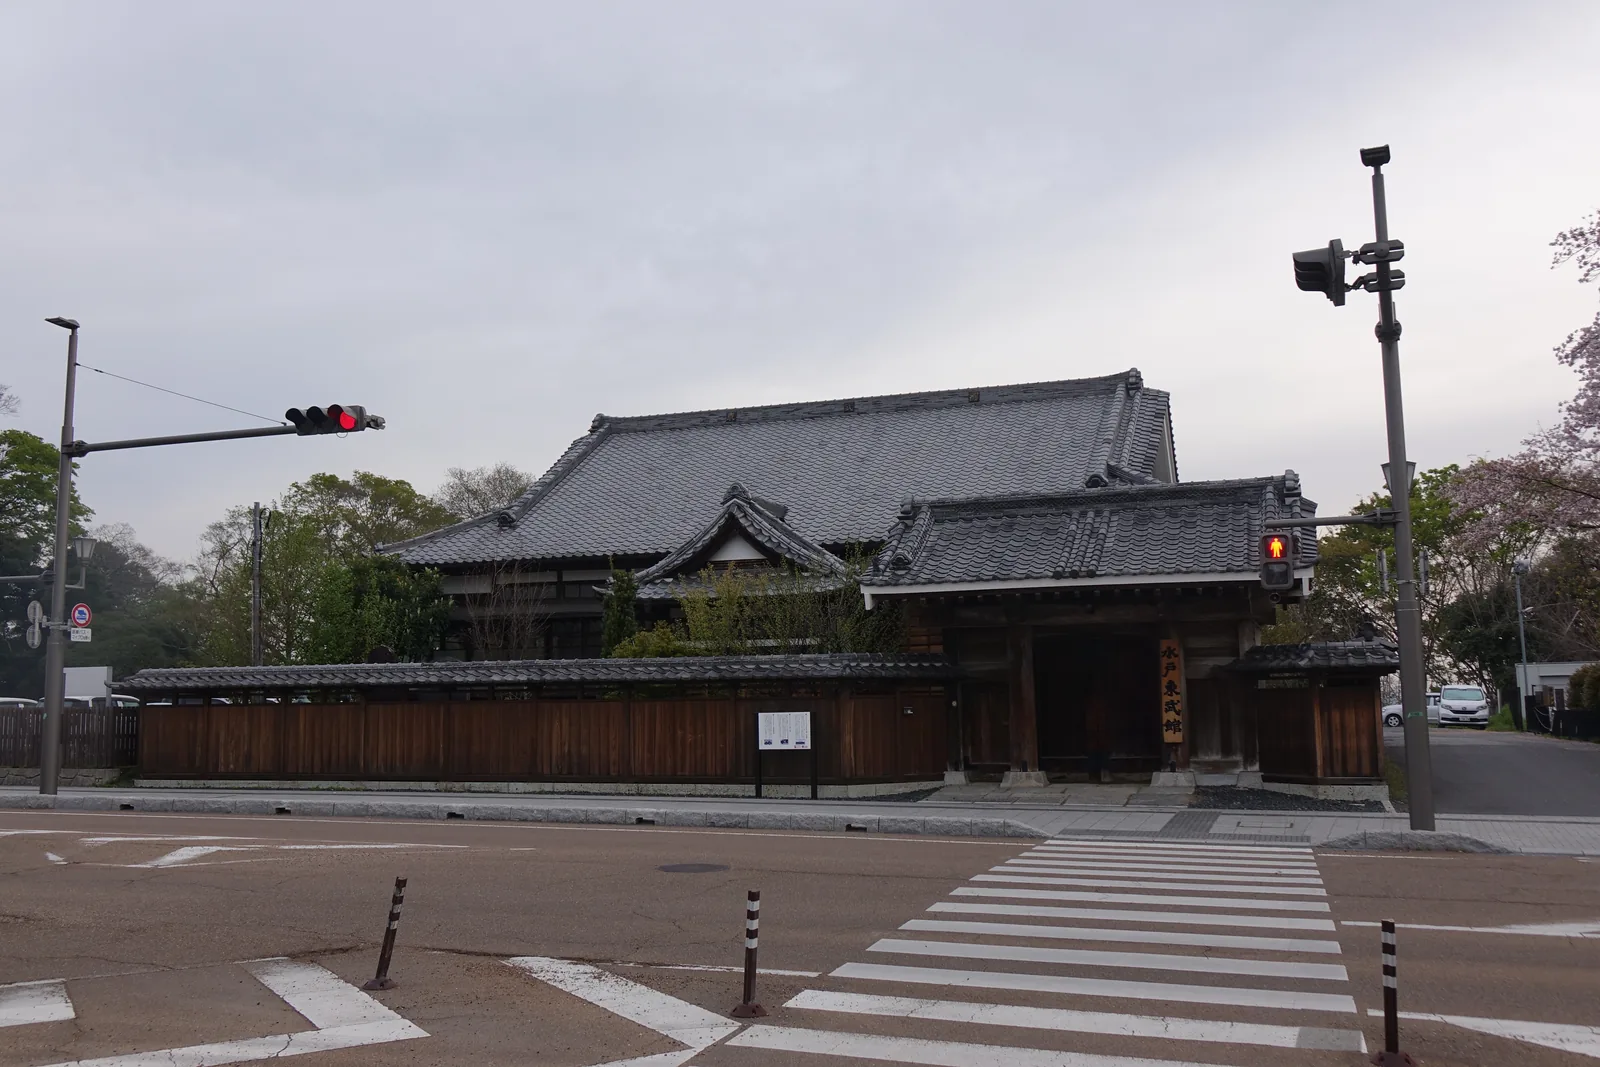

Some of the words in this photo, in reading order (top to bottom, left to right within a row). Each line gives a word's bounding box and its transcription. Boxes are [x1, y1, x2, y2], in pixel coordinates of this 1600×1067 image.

[1161, 645, 1182, 735] 水戸東武館
